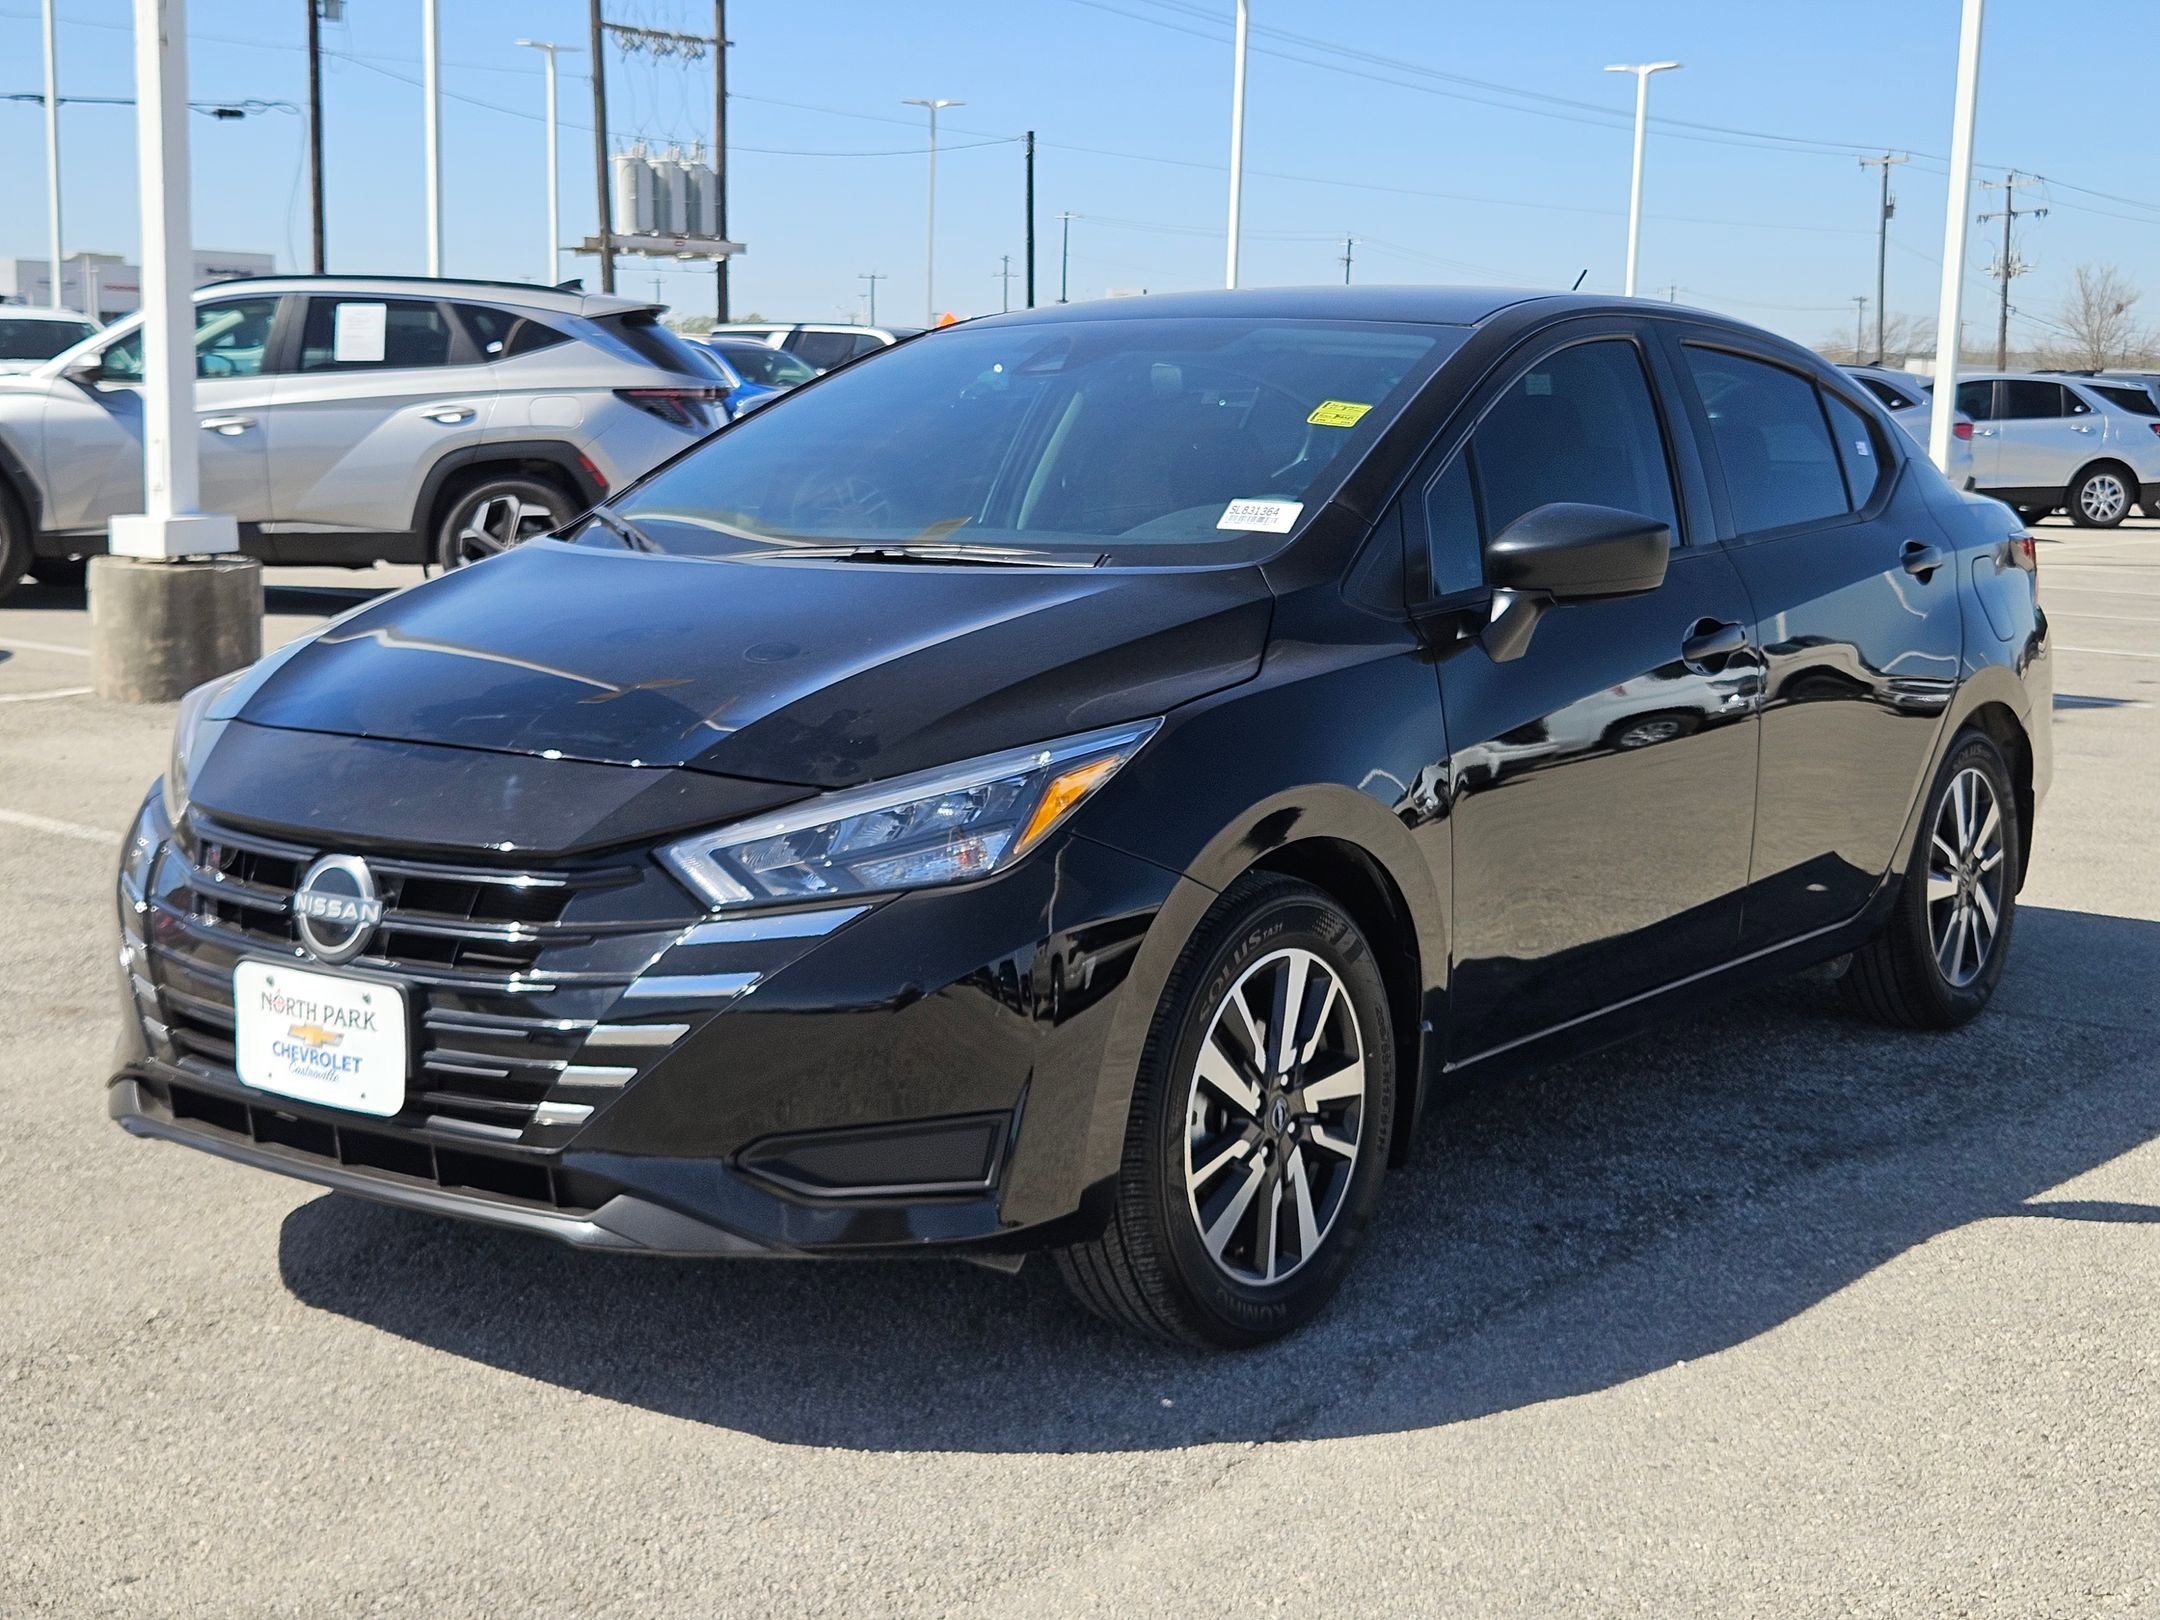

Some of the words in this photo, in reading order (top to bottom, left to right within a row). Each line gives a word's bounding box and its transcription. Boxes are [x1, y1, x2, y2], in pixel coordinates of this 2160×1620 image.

[1229, 505, 1280, 516] SL831364
[296, 893, 380, 922] NISSAN
[1200, 929, 1262, 1021] SOLUS
[261, 989, 317, 1021] NORTH
[323, 1005, 378, 1032] PARK
[272, 1040, 363, 1074] CHEVROLET
